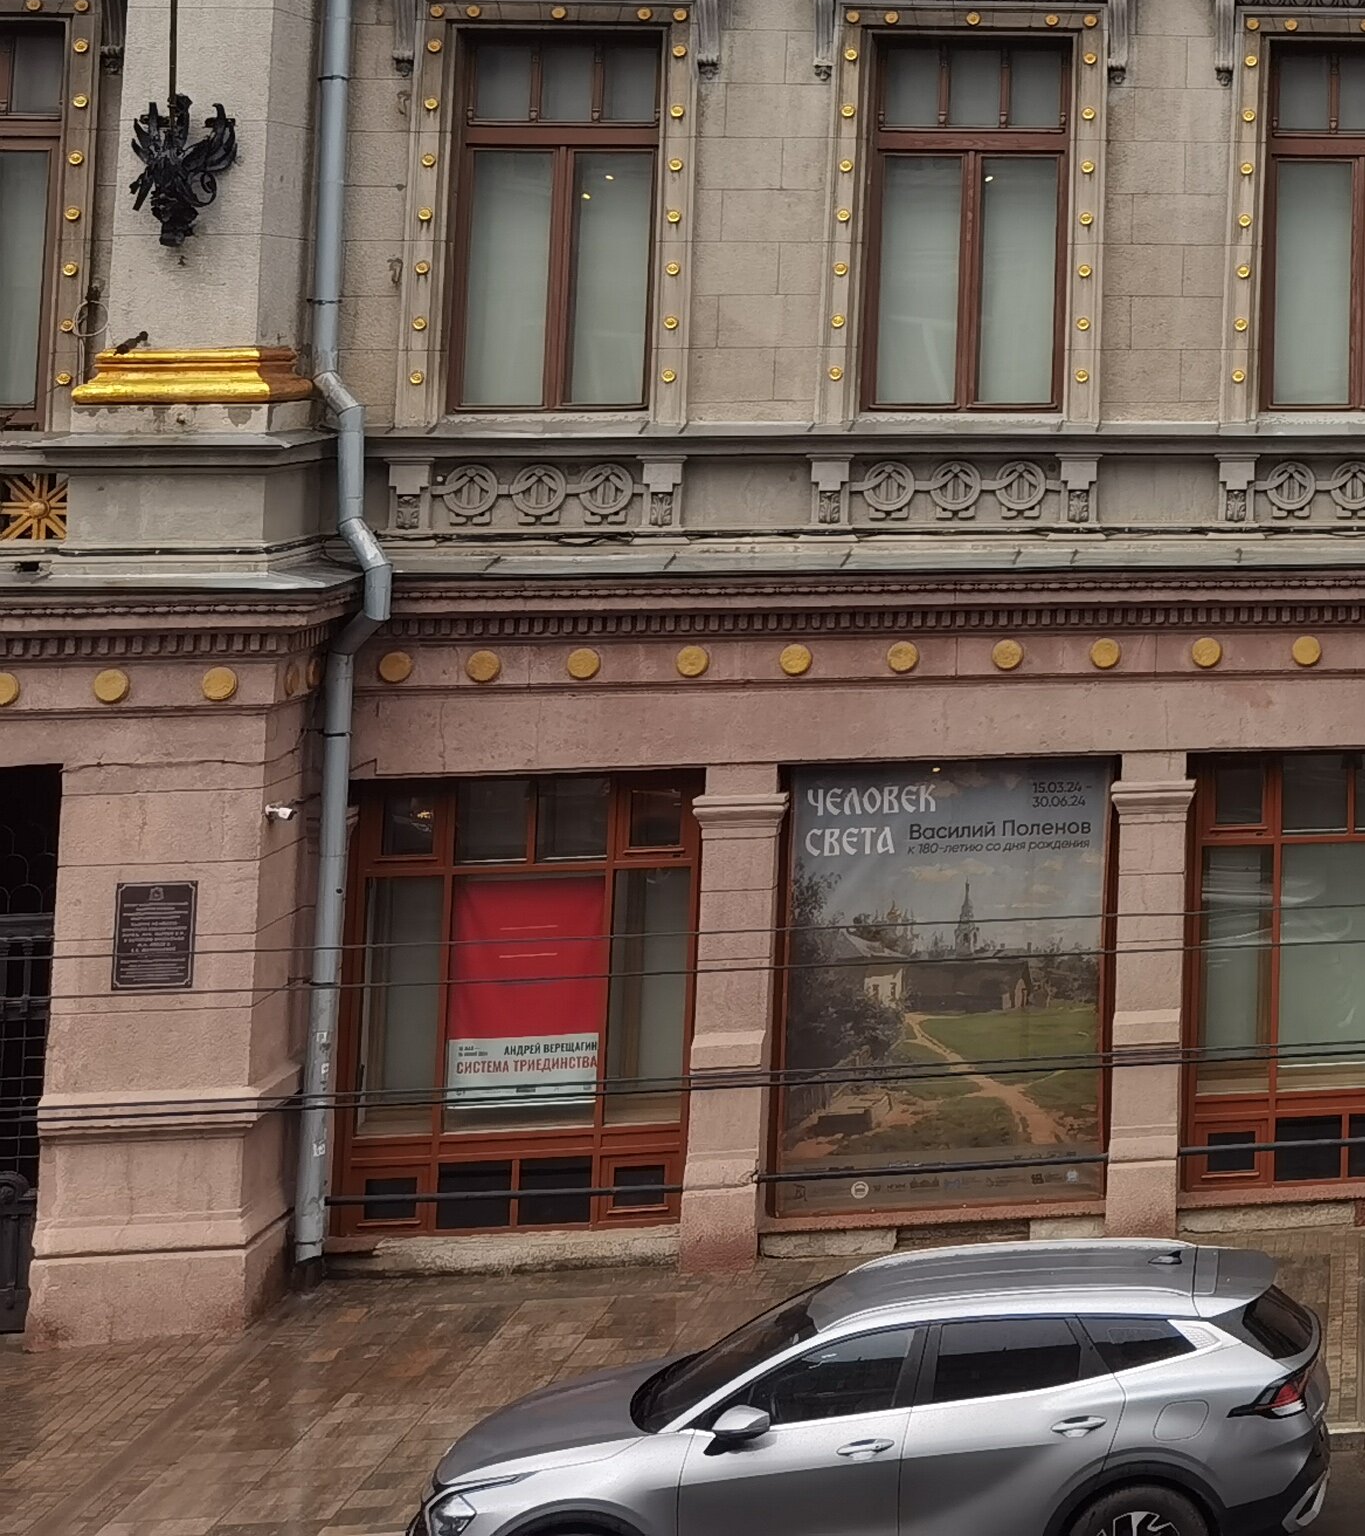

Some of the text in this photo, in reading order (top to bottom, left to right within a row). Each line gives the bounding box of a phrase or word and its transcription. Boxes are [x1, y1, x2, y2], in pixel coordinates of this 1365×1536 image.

[1032, 781, 1082, 794] 15.03.24
[807, 784, 936, 816] ЧЕЛОВЕК
[1032, 795, 1086, 808] 30.06.24
[909, 819, 1092, 840] Василий Поленов
[804, 826, 896, 857] СВЕТА
[907, 839, 1090, 855] к 180-летию со дня рождения
[504, 1041, 597, 1056] АНДРЕЙ ВЕРЕЩАГИН
[456, 1056, 598, 1074] СИСТЕМА ТРИЕДИНСТВА
